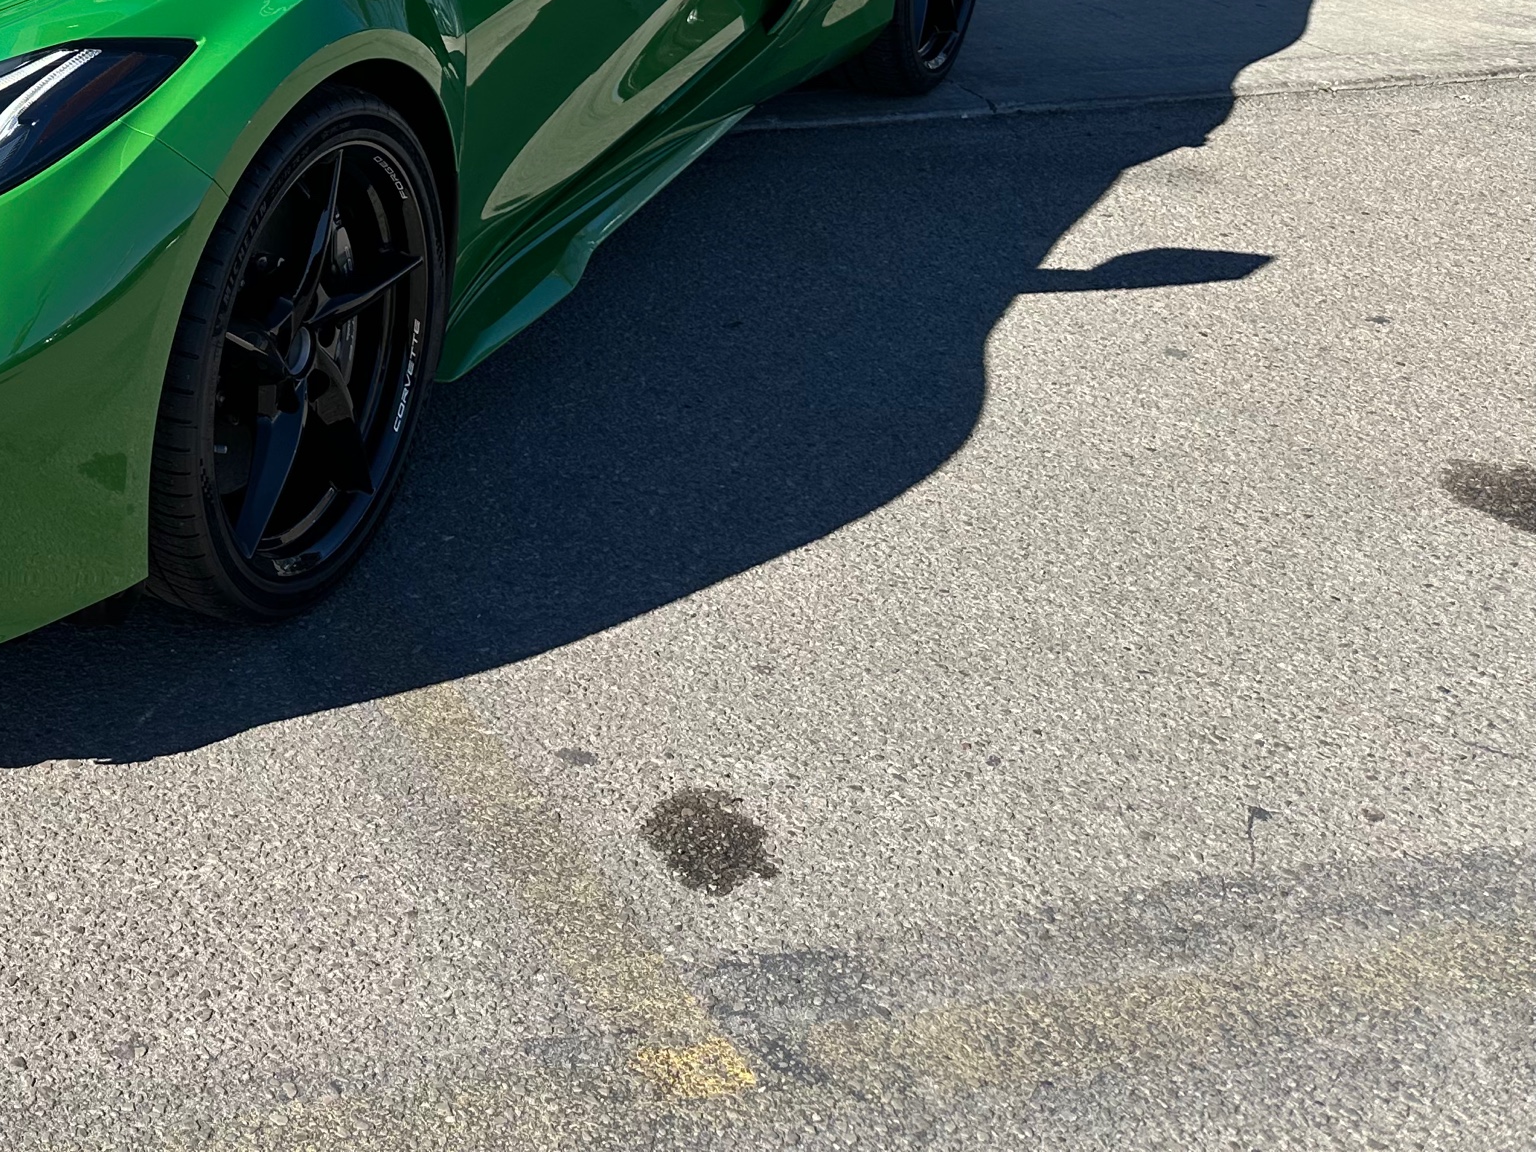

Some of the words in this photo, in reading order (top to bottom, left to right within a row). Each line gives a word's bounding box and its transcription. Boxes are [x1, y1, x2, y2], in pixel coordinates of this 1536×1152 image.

[372, 155, 408, 200] FORGED
[222, 201, 267, 305] MICHELIN
[393, 318, 421, 433] CORVETTE
